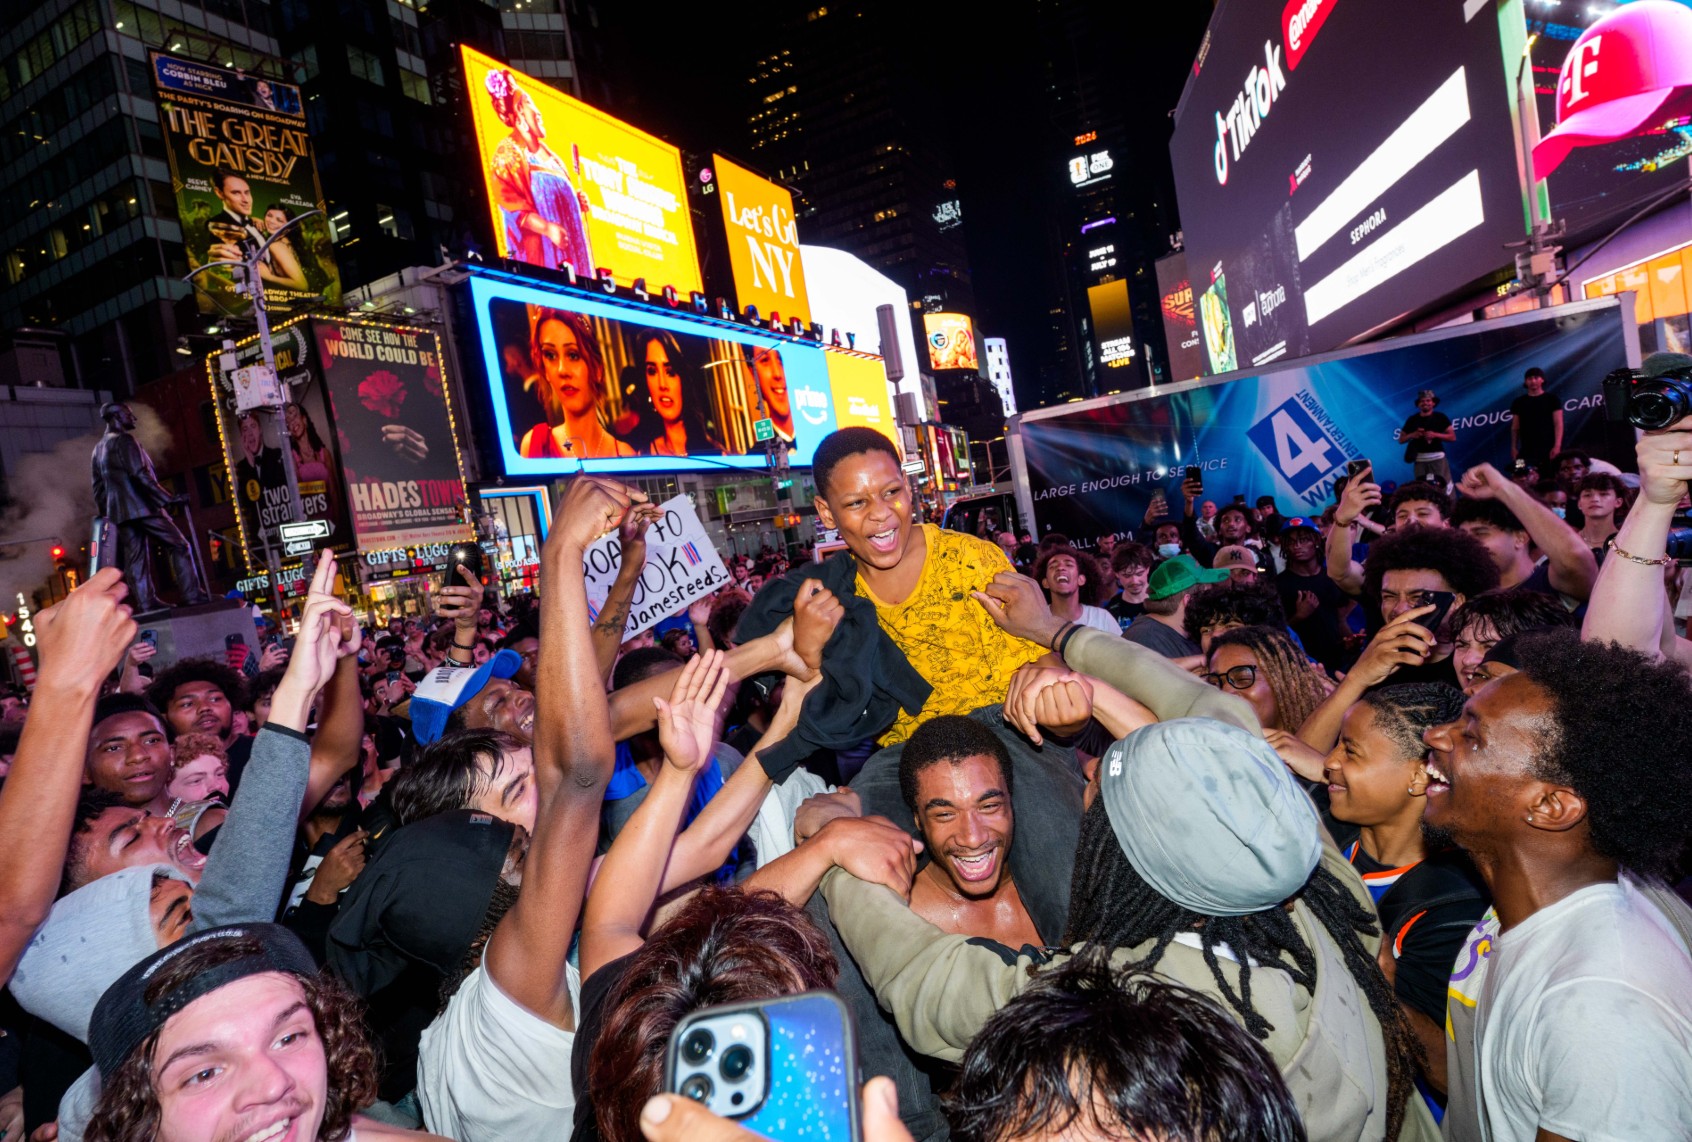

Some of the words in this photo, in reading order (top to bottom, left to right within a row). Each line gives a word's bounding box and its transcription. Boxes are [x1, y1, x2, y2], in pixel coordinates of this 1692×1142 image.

[163, 69, 201, 83] CORBIN
[203, 76, 227, 89] BLEU
[166, 63, 185, 73] NOW
[187, 67, 223, 81] STARRING
[158, 91, 176, 101] THE
[177, 94, 212, 109] PARTY'S
[213, 103, 250, 117] ROARING
[251, 111, 263, 120] ON
[264, 113, 307, 128] BROADWAY
[1226, 40, 1287, 162] TikTok
[167, 105, 217, 141] THE
[222, 117, 310, 157] GREAT
[188, 138, 298, 179] GATSBY
[185, 183, 213, 193] CARNEY
[702, 183, 714, 195] LG
[726, 191, 773, 238] Let's
[1350, 207, 1387, 245] SEPHORA
[746, 235, 795, 299] NY
[567, 257, 679, 307] 1540
[687, 290, 856, 350] BROADWAY
[325, 338, 374, 361] WORLD
[376, 345, 418, 365] COULD
[419, 350, 435, 367] BE
[340, 326, 363, 342] COME
[365, 329, 382, 344] SEE
[383, 332, 401, 346] HOW
[402, 333, 418, 348] THE
[1295, 388, 1360, 463] ENTERTAINMENT
[1452, 410, 1514, 430] ENOUG
[1563, 394, 1606, 411] CAR
[1271, 408, 1333, 479] 4
[263, 485, 290, 509] two
[351, 479, 465, 512] HADESTOWN
[1033, 484, 1076, 501] LARGE
[1081, 473, 1140, 493] ENOUGH
[1146, 468, 1164, 482] TO
[357, 510, 404, 521] BROADWAY'S
[405, 506, 431, 517] GLOBAL
[367, 547, 407, 566] GIFTS
[236, 575, 270, 593] GIFTS
[16, 591, 36, 647] 1540
